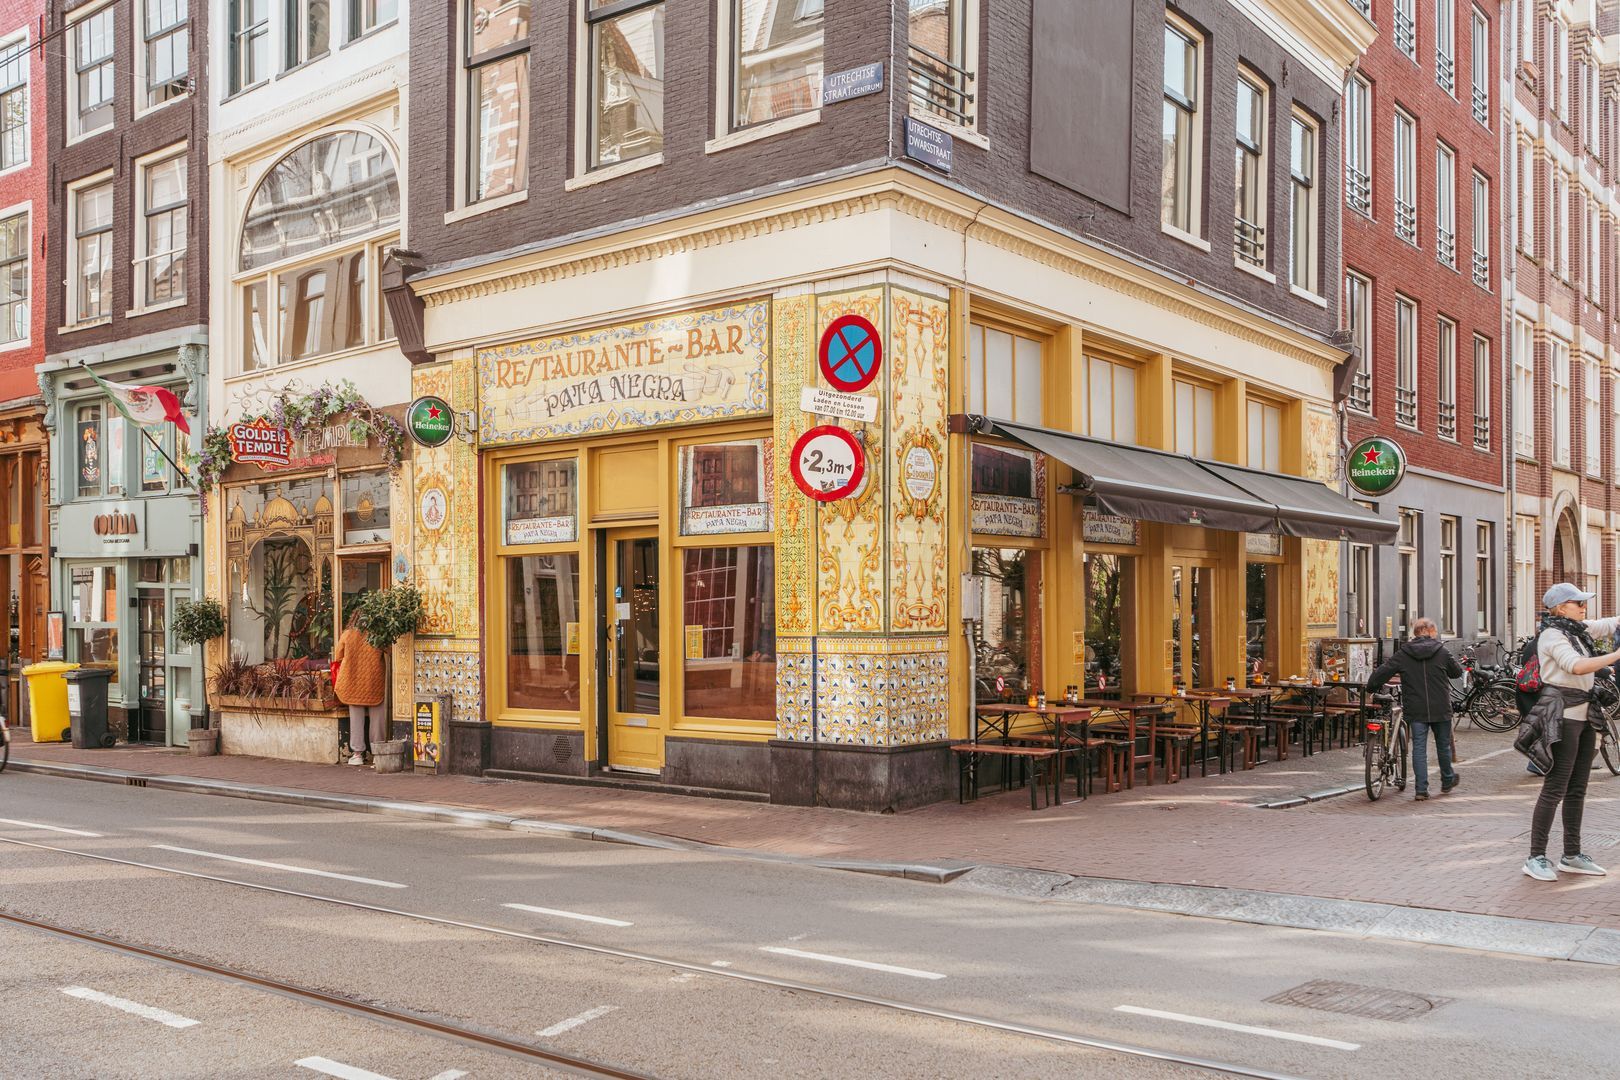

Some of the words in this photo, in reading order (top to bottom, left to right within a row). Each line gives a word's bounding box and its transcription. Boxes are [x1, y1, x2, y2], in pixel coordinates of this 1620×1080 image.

[830, 67, 875, 86] UTRECHTSE
[824, 86, 852, 102] STRAAT
[909, 122, 944, 144] UTRECHTSE-
[909, 135, 951, 160] DWARSSTRAAT
[544, 375, 605, 417] PATA
[609, 373, 687, 402] NEGRA
[813, 396, 832, 404] Laden
[843, 402, 865, 410] Lossen
[818, 390, 862, 402] Uitgezonderd
[234, 425, 286, 443] GOLDEN
[415, 422, 449, 431] Heineken
[236, 440, 288, 456] TEMPLE
[808, 450, 845, 474] 2,3m
[1352, 468, 1395, 477] Heineken
[706, 518, 724, 528] PATA
[726, 518, 748, 527] NEGRA
[984, 514, 1002, 526] PATA
[1004, 514, 1023, 529] NEGRA
